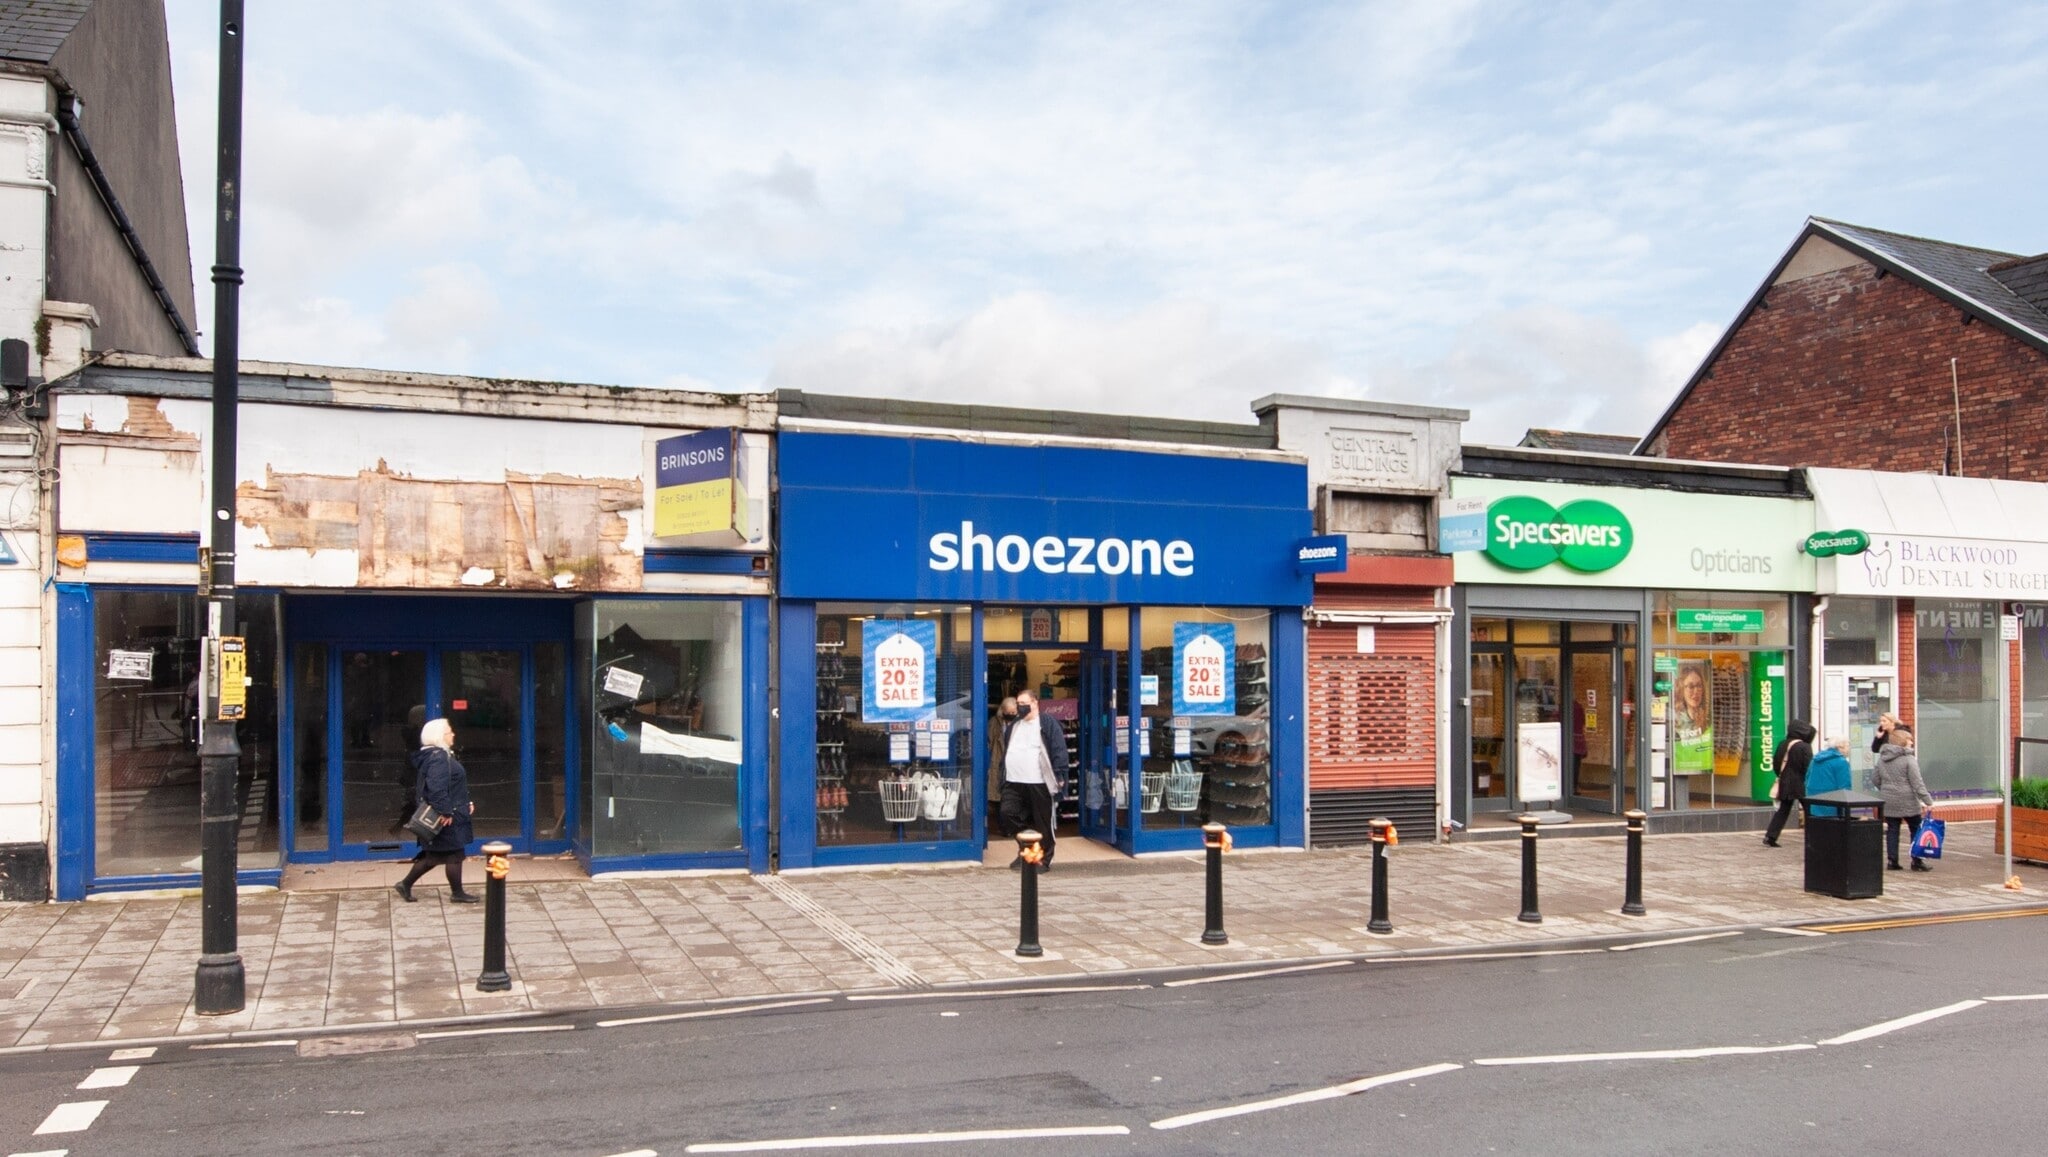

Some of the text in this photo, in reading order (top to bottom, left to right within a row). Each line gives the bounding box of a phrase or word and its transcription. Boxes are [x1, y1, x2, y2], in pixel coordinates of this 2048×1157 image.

[1331, 436, 1407, 456] CENTRAL
[661, 447, 724, 470] BRINSONS
[1331, 454, 1409, 474] BUILDINGS
[660, 496, 673, 504] For
[1456, 500, 1482, 511] For Rent
[1496, 515, 1621, 549] Specsavers
[929, 521, 1194, 577] shoezone
[1809, 535, 1859, 550] Specsavers
[1298, 546, 1337, 560] shoezone
[1690, 547, 1772, 576] Opticians
[1901, 541, 2018, 565] BLACKWOOD
[1901, 566, 1973, 588] DENTAL
[1694, 613, 1747, 622] Chiropodist
[880, 658, 918, 667] EXTRA
[1188, 657, 1220, 666] EXTRA
[882, 688, 918, 701] SALE
[1188, 684, 1220, 696] SALE
[1759, 680, 1774, 772] Contact Lenses
